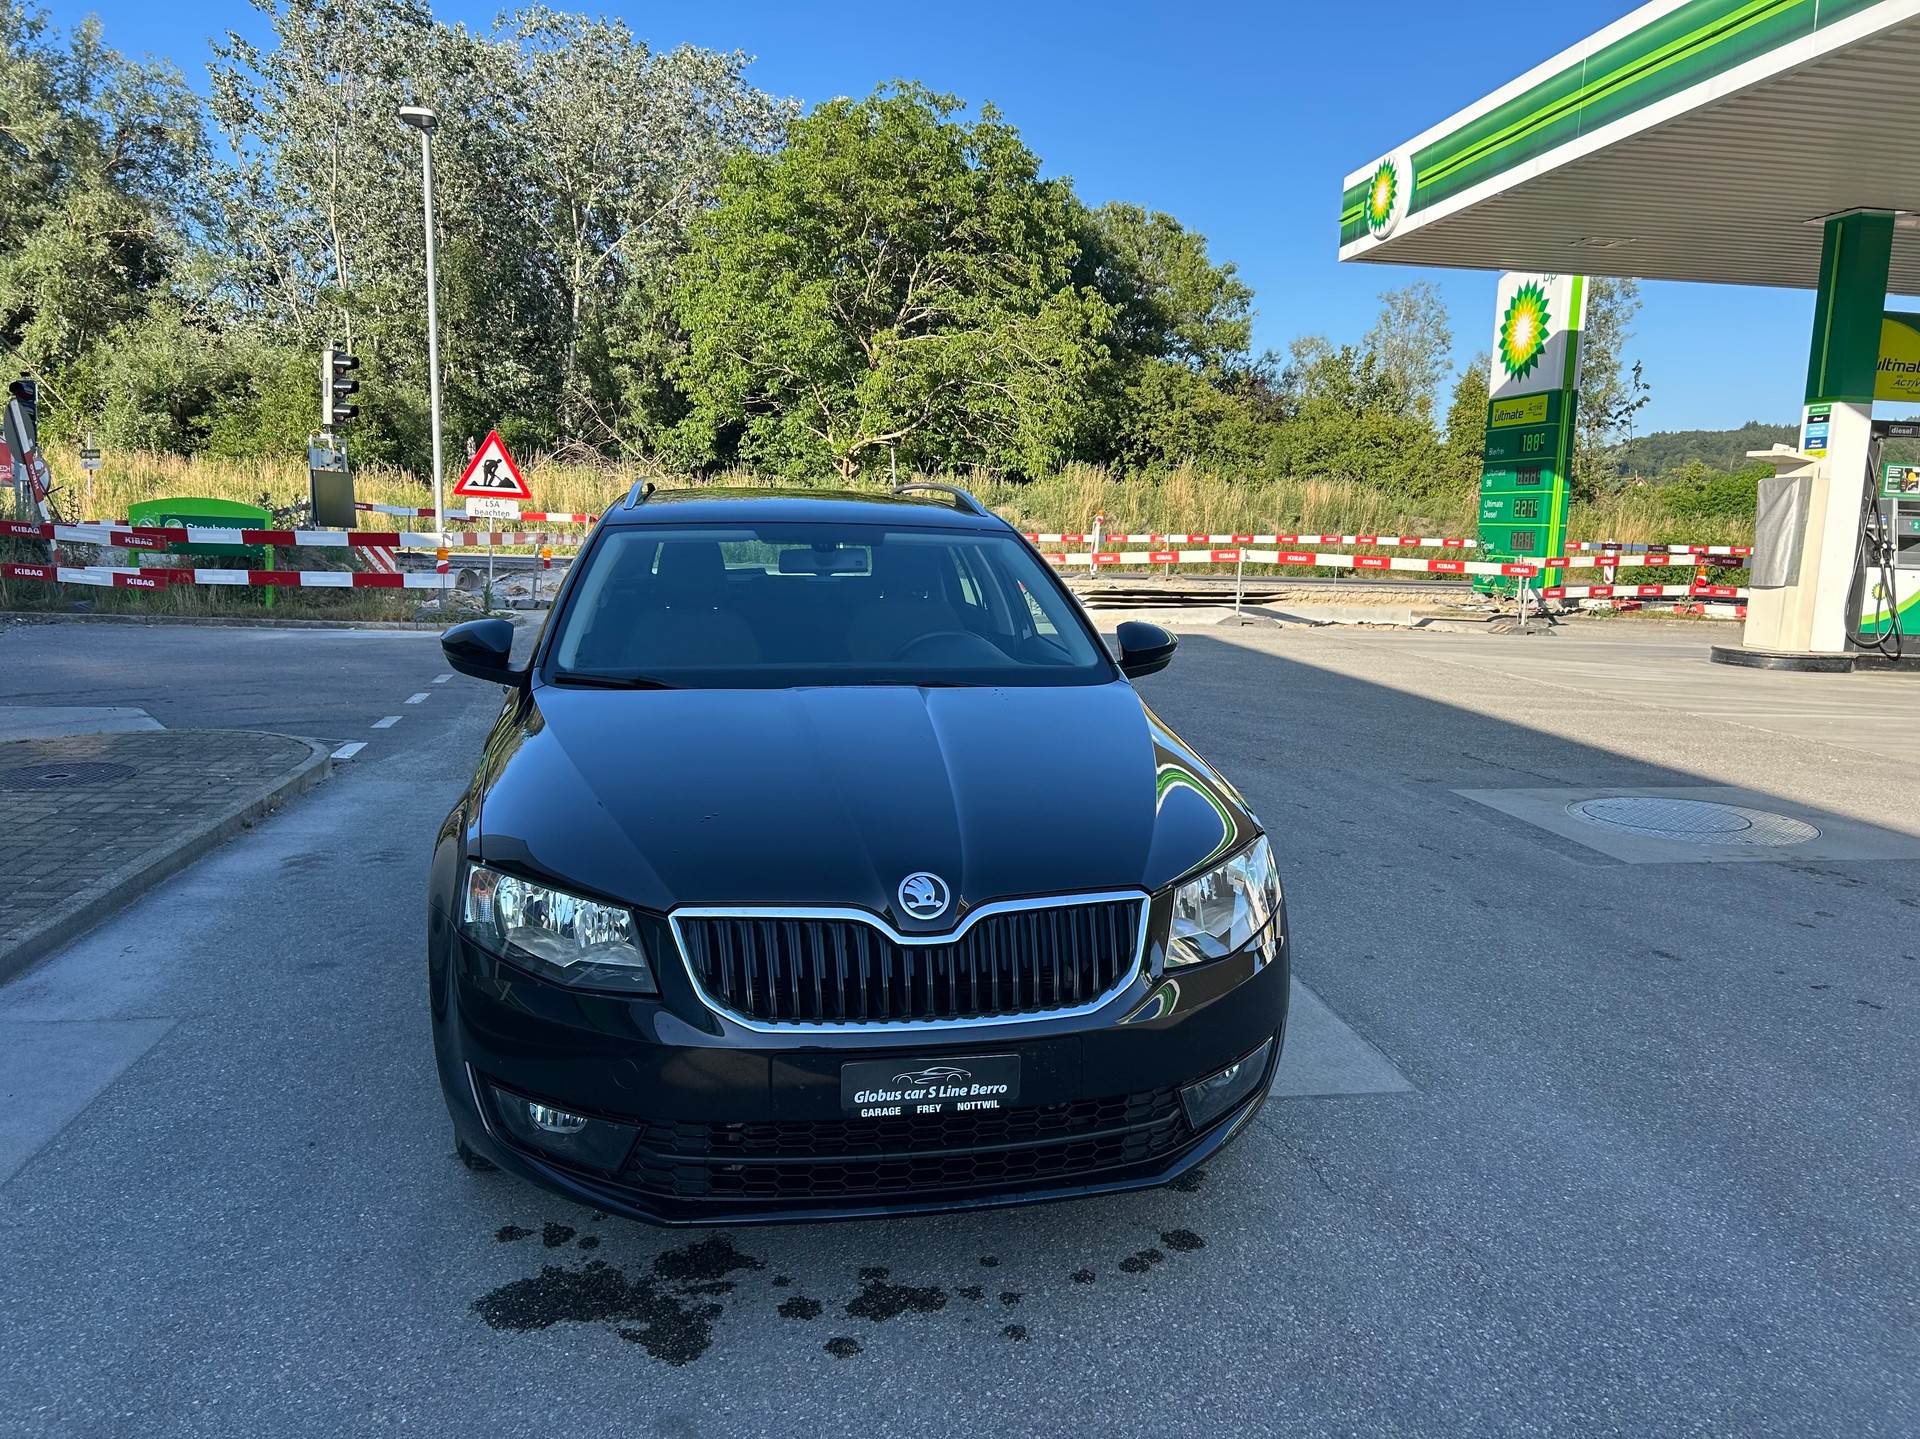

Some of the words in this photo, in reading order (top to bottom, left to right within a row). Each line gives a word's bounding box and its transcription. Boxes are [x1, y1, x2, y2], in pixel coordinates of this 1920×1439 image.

[1494, 408, 1524, 422] ultimate
[474, 508, 510, 517] beachten
[10, 525, 40, 535] KIBAG
[124, 536, 153, 546] KIBAG
[14, 568, 43, 577] KIBAG
[126, 578, 155, 587] KIBAG
[854, 1089, 902, 1104] Globus
[904, 1088, 926, 1100] car
[928, 1086, 936, 1098] S
[938, 1084, 966, 1098] Line
[970, 1083, 1008, 1096] Berro
[861, 1106, 901, 1118] GARAGE
[917, 1104, 942, 1114] FREY
[957, 1100, 1000, 1111] NOTTWIL
